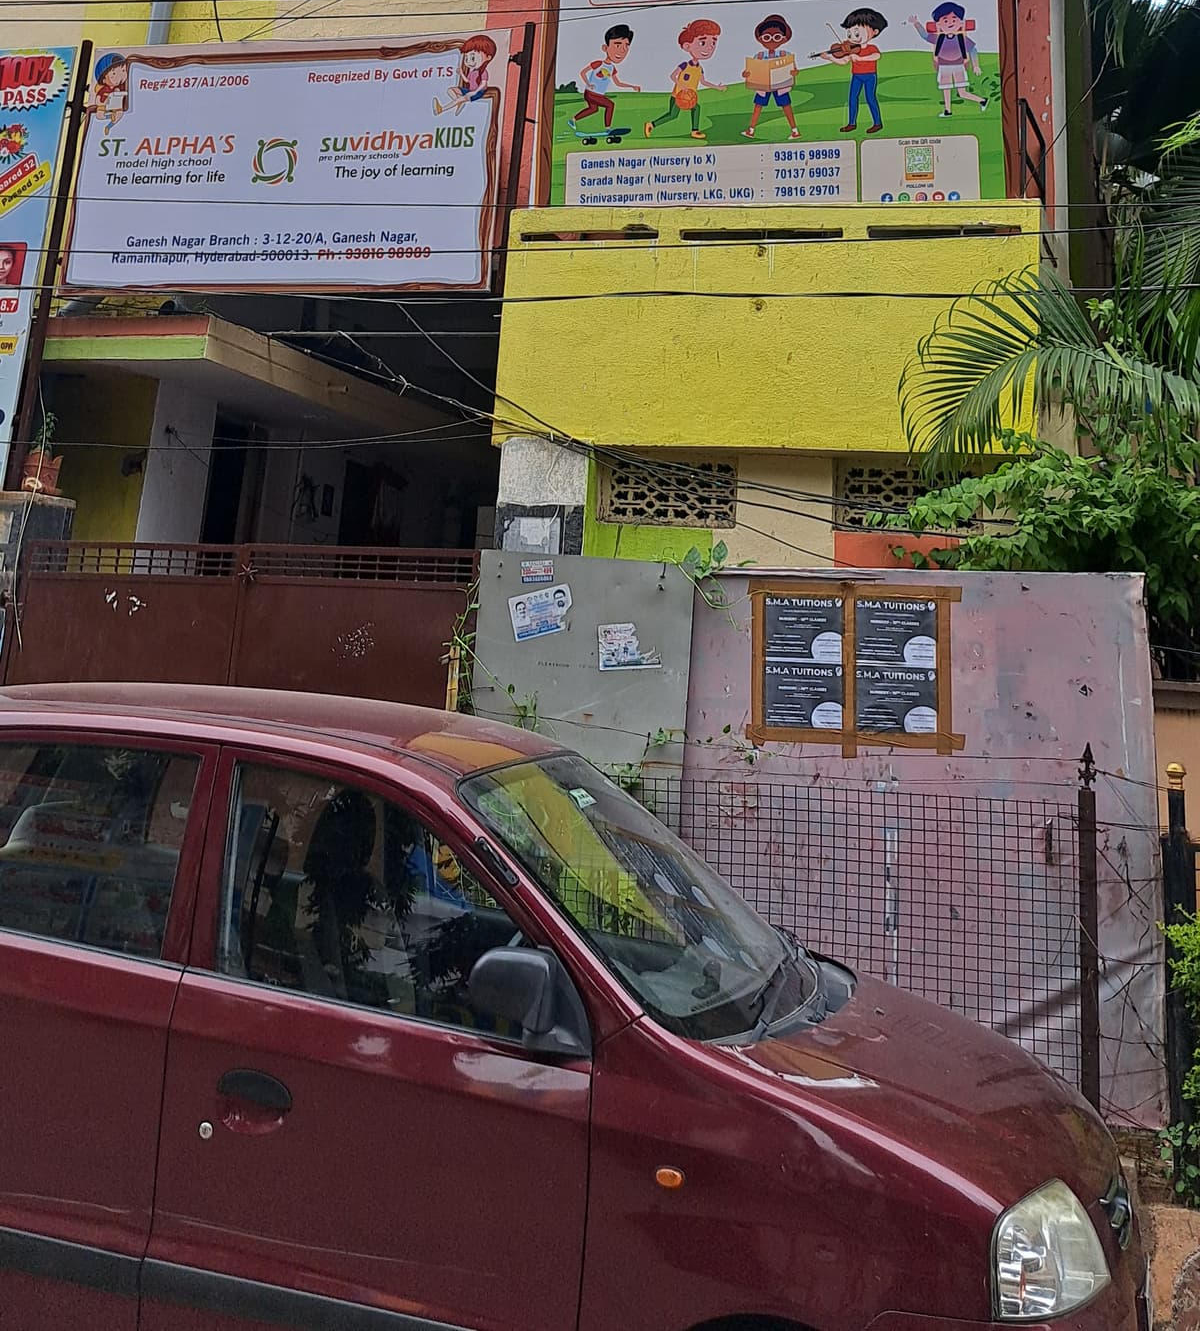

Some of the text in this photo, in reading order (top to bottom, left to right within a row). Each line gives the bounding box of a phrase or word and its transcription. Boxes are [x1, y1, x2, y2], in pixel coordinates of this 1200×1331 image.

[139, 74, 250, 91] Reg#2187/A1/2006
[308, 67, 433, 85] Recognized By Govt of
[3, 88, 47, 106] PASS
[98, 134, 236, 157] ST. ALPHA'S
[320, 126, 475, 156] suvidhyaKIDS
[116, 157, 213, 170] model high school
[334, 153, 367, 163] primary
[368, 152, 400, 160] schools
[580, 150, 805, 170] Ganesh Nagar (Nursery 93816
[33, 170, 46, 182] 32
[105, 170, 226, 185] The learning for life
[335, 164, 455, 180] The joy of learning
[580, 166, 841, 187] Sarada Nagar Nursery 70137 69037
[579, 184, 841, 205] Srinivasapuram 79816 29701
[126, 230, 418, 249] Ganesh Nagar Branch Ganesh Nagar,
[791, 599, 833, 607] TUITIONS
[883, 601, 926, 611] TUITIONS
[791, 667, 833, 677] TUITIONS
[882, 671, 926, 681] TUITIONS
